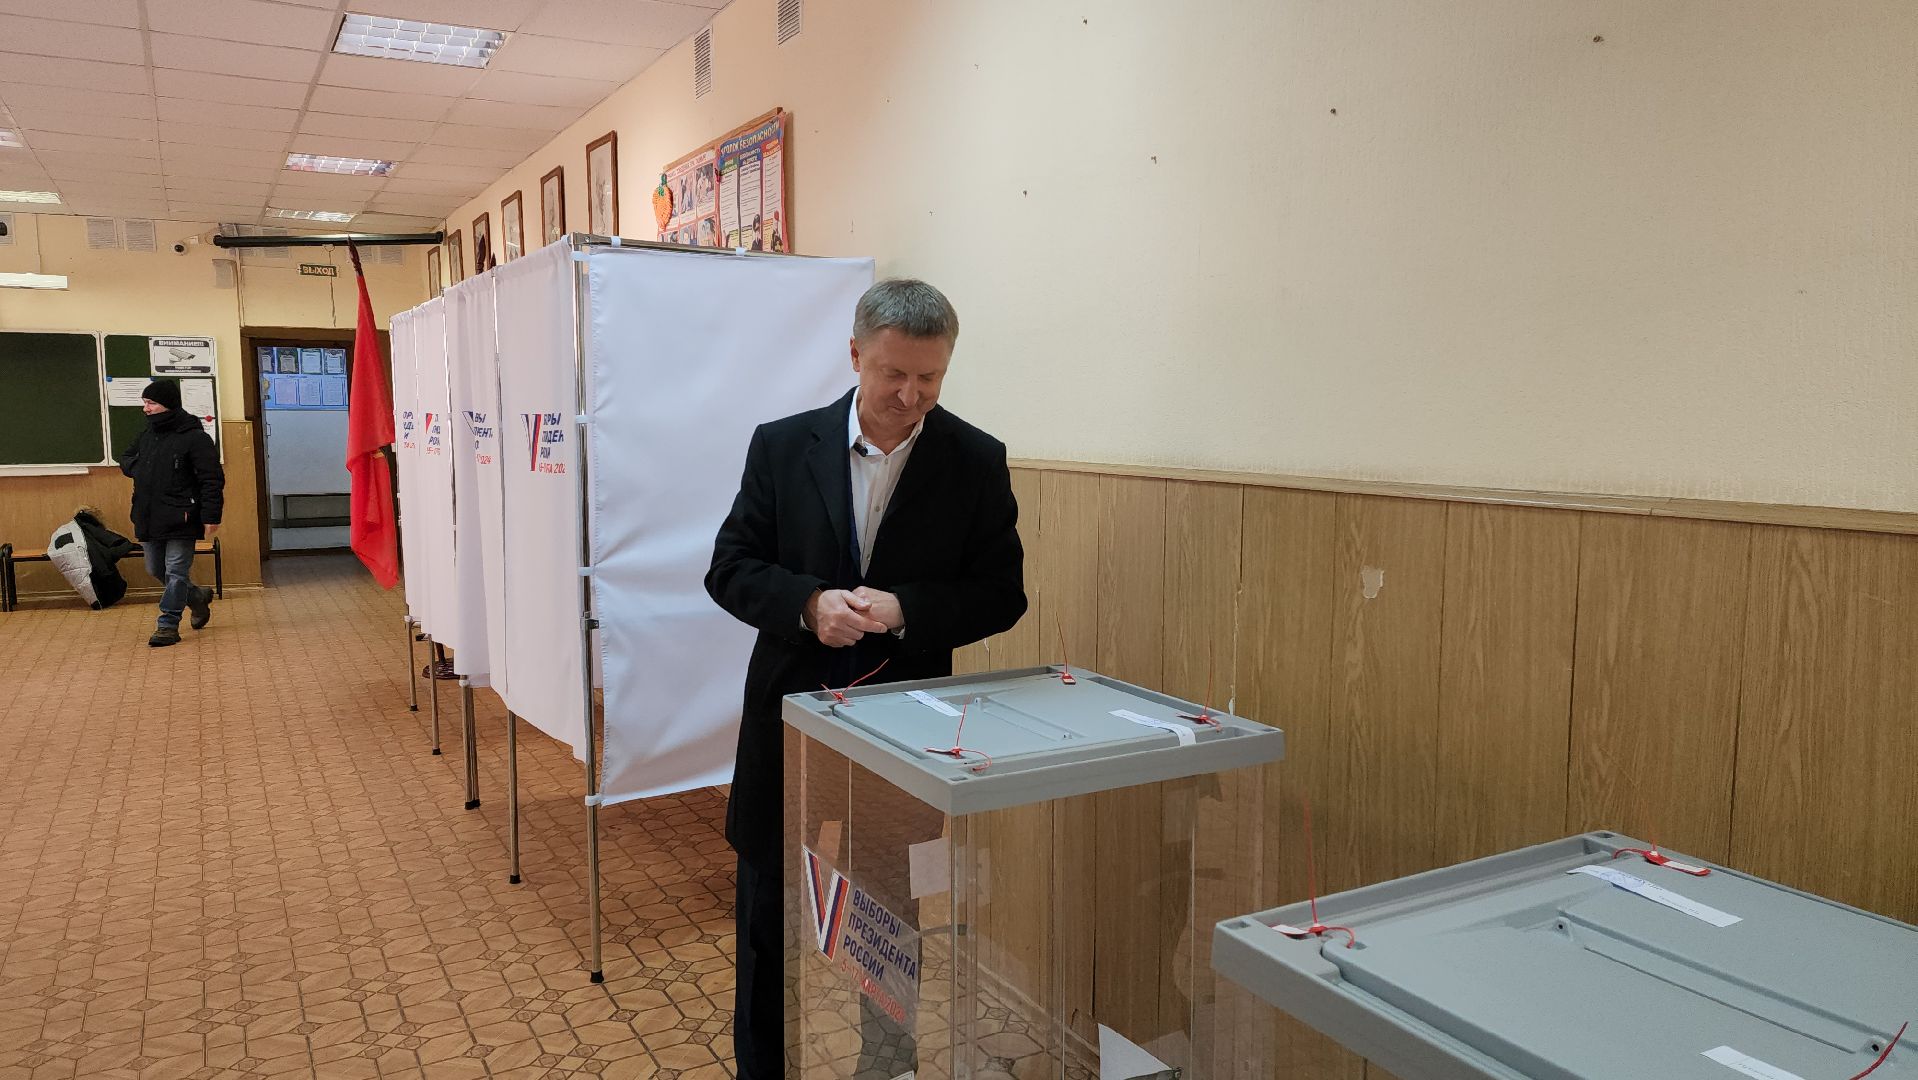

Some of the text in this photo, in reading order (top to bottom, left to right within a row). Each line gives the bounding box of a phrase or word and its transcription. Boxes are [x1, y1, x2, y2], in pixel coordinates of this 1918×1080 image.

[302, 265, 335, 276] ВЫХОД
[853, 889, 902, 938] ВЫБОРЫ
[843, 935, 885, 982] РОССИИ
[847, 911, 917, 980] ПРЕЗИДЕНТА
